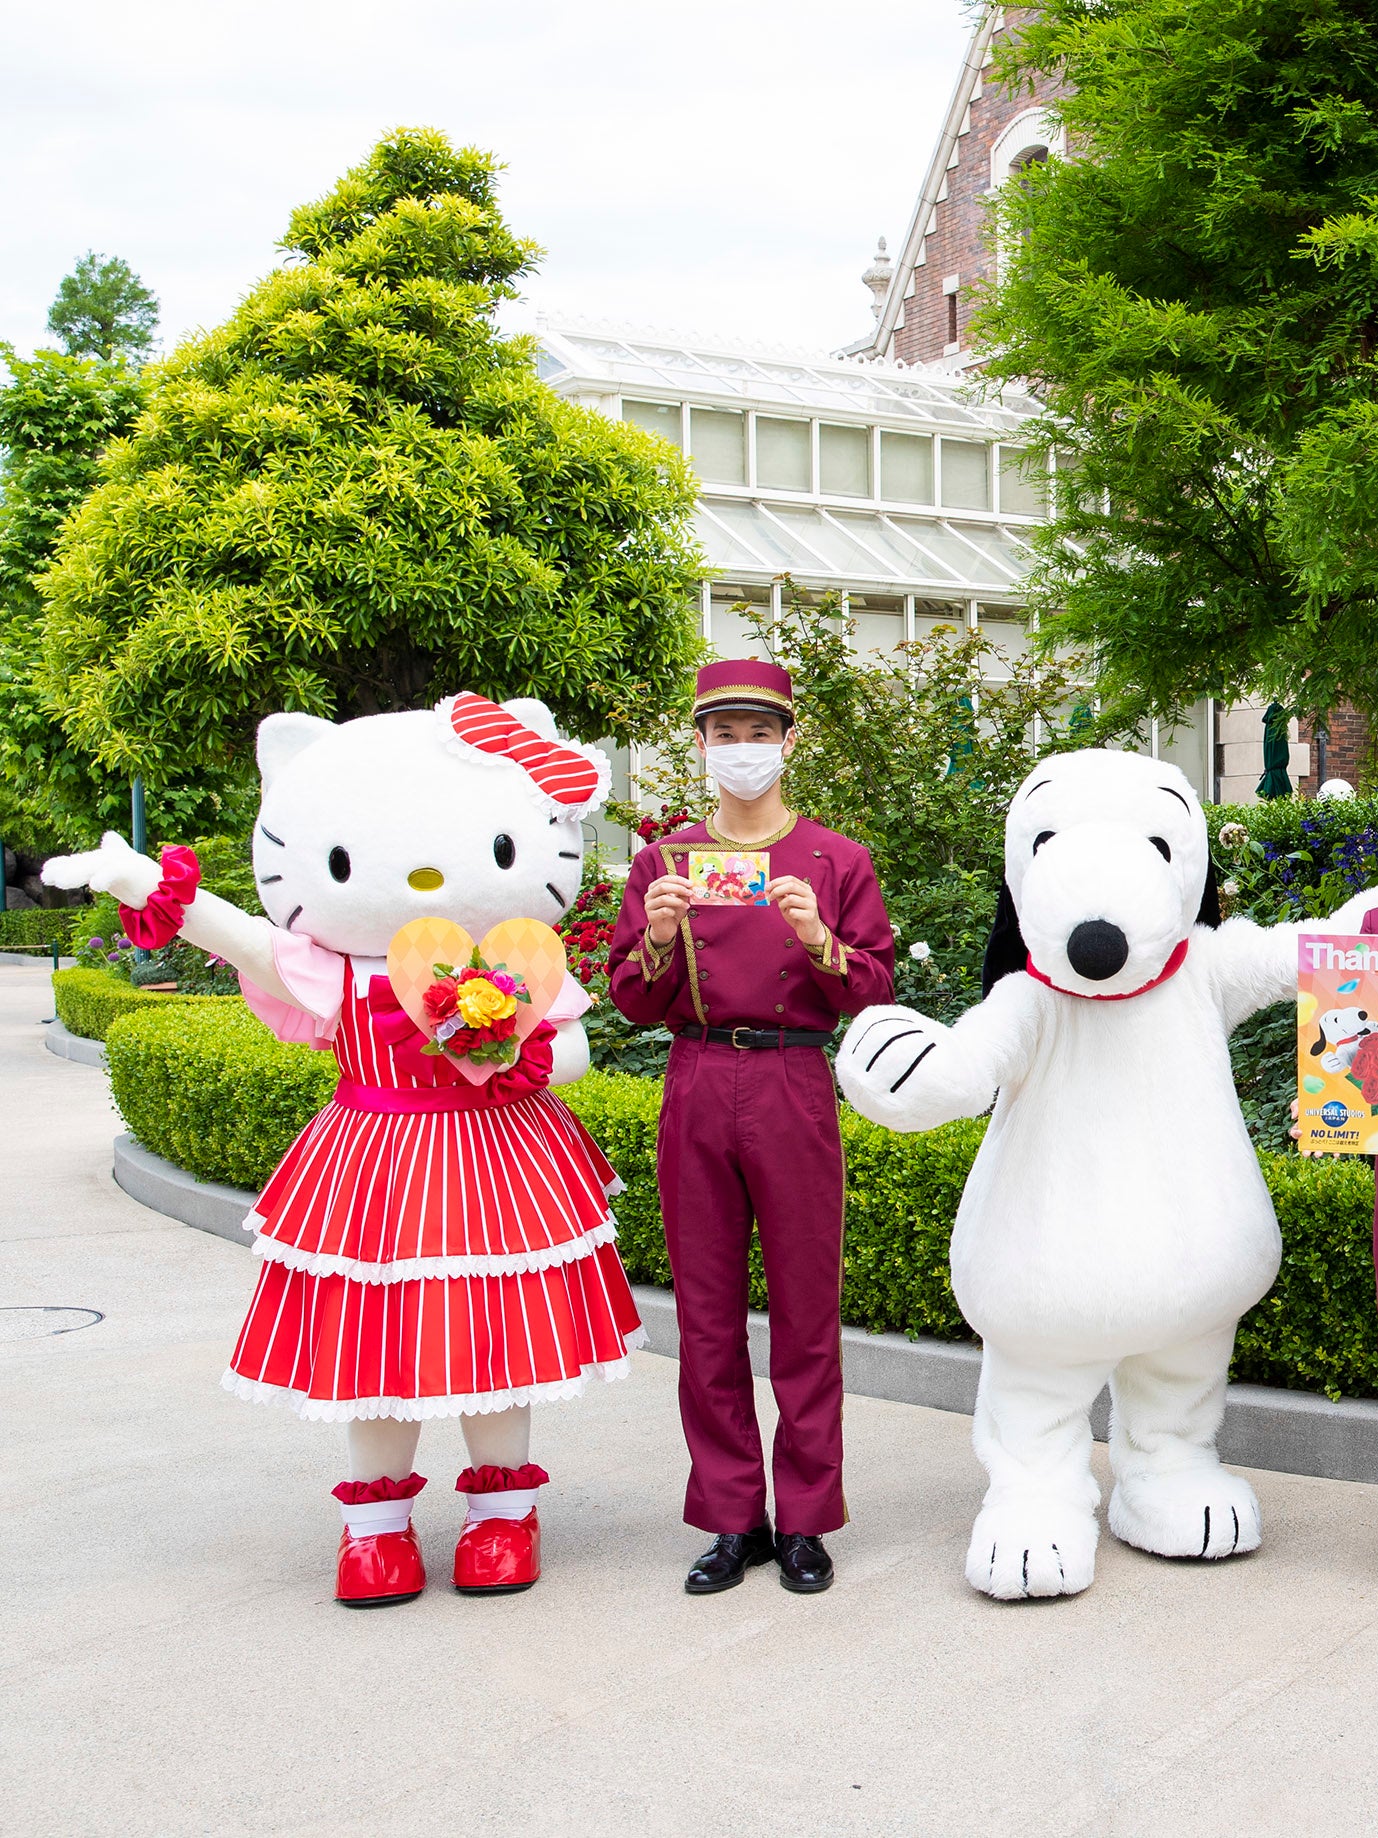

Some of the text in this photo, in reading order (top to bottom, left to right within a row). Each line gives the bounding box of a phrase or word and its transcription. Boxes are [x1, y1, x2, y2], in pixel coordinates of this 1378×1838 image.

[1306, 1108, 1338, 1116] UNIVERSAL
[1310, 1129, 1359, 1139] NO LIMIT!
